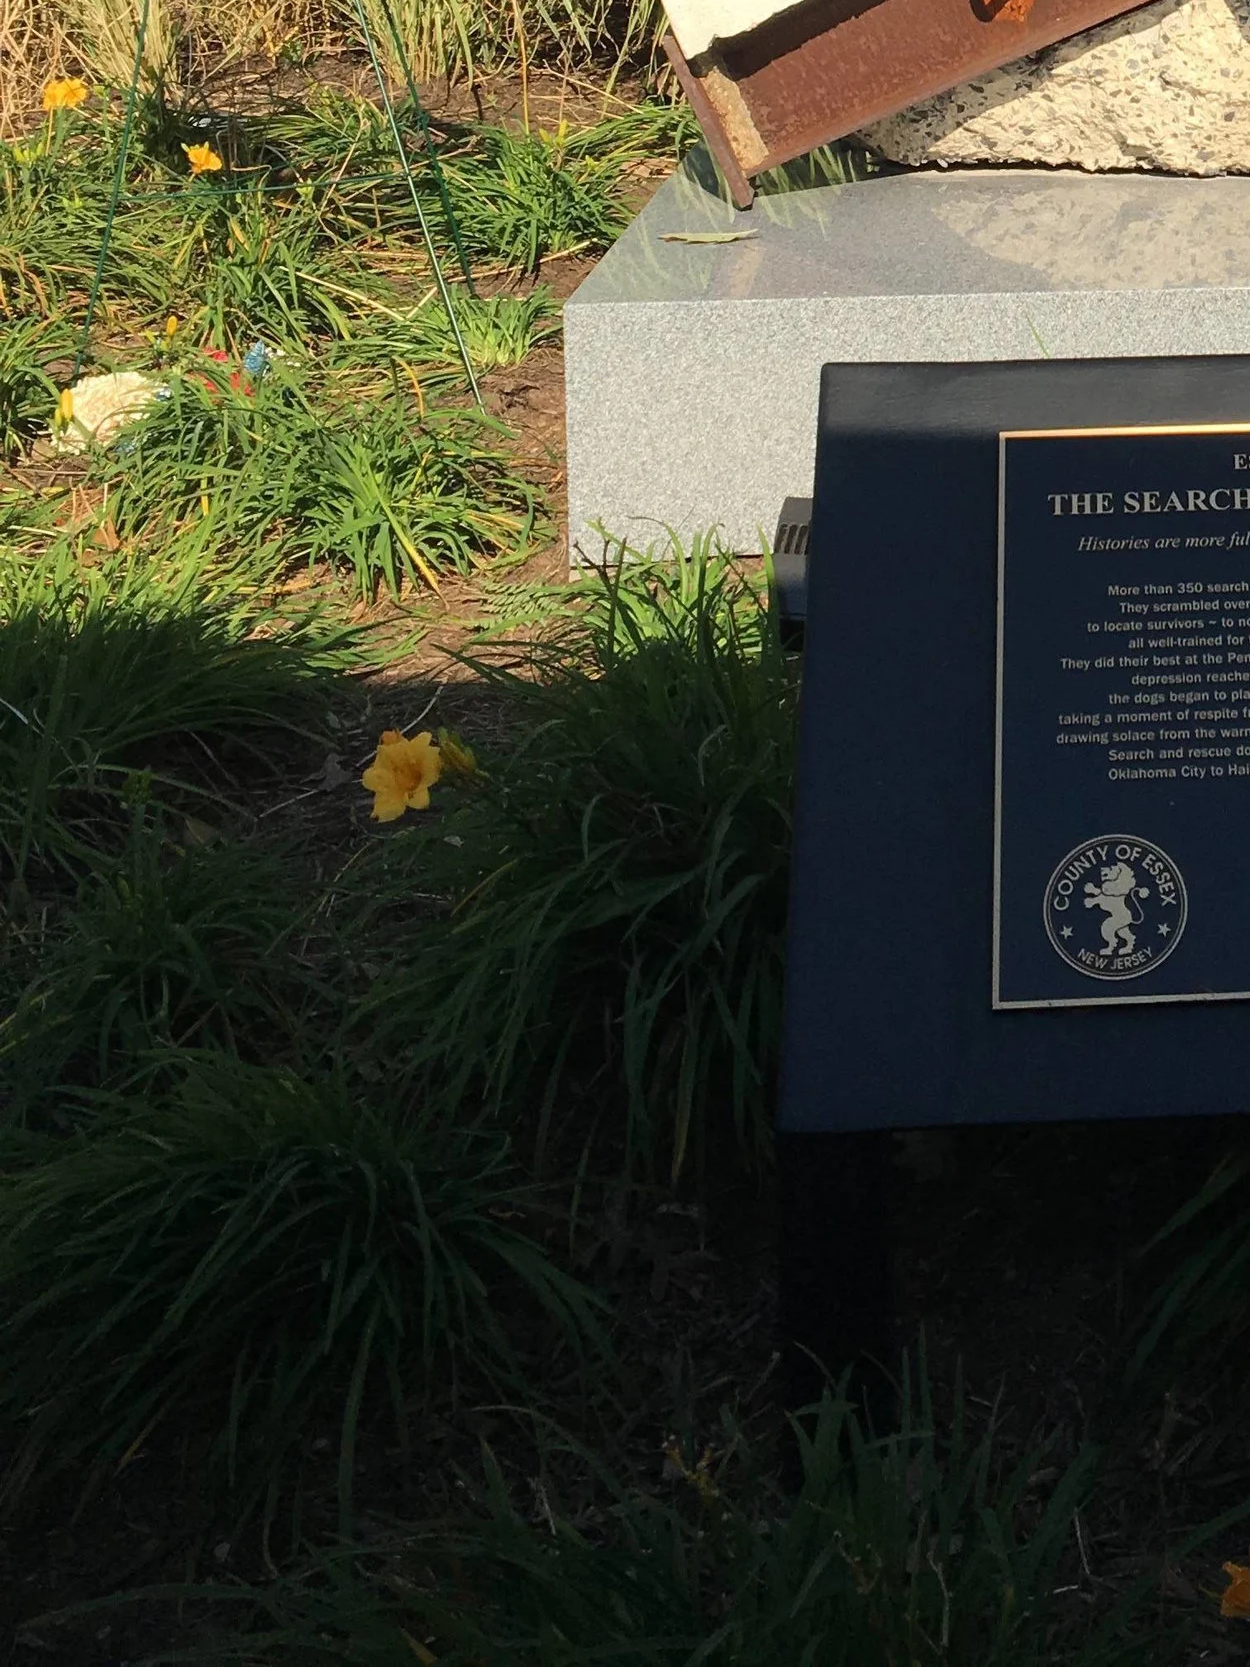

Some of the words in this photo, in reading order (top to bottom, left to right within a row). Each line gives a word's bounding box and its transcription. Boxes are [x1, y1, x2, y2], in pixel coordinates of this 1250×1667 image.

[1048, 493, 1114, 515] THE
[1078, 535, 1150, 551] Histories
[1155, 538, 1180, 548] are
[1185, 536, 1225, 547] more
[1108, 585, 1140, 596] More
[1144, 584, 1173, 595] than
[1177, 582, 1203, 594] 350
[1207, 581, 1249, 592] search
[1119, 602, 1149, 615] They
[1153, 599, 1219, 612] scrambled
[1224, 600, 1250, 610] over
[1128, 638, 1144, 648] all
[1148, 634, 1223, 648] well-trained
[1227, 634, 1245, 645] for
[1058, 713, 1100, 726] taking
[1104, 714, 1112, 723] a
[1117, 710, 1172, 723] moment
[1176, 708, 1189, 720] of
[1194, 708, 1238, 721] respite
[1109, 748, 1154, 761] Search
[1159, 747, 1183, 759] and
[1188, 747, 1231, 758] rescue
[1108, 768, 1176, 780] Oklahoma
[1181, 765, 1206, 779] City
[1211, 766, 1224, 777] to
[1054, 845, 1108, 910] COUNTY
[1116, 844, 1142, 861] OF
[1142, 854, 1176, 906] ESSEX
[1078, 948, 1108, 969] NEW
[1110, 947, 1152, 970] JERSEY
